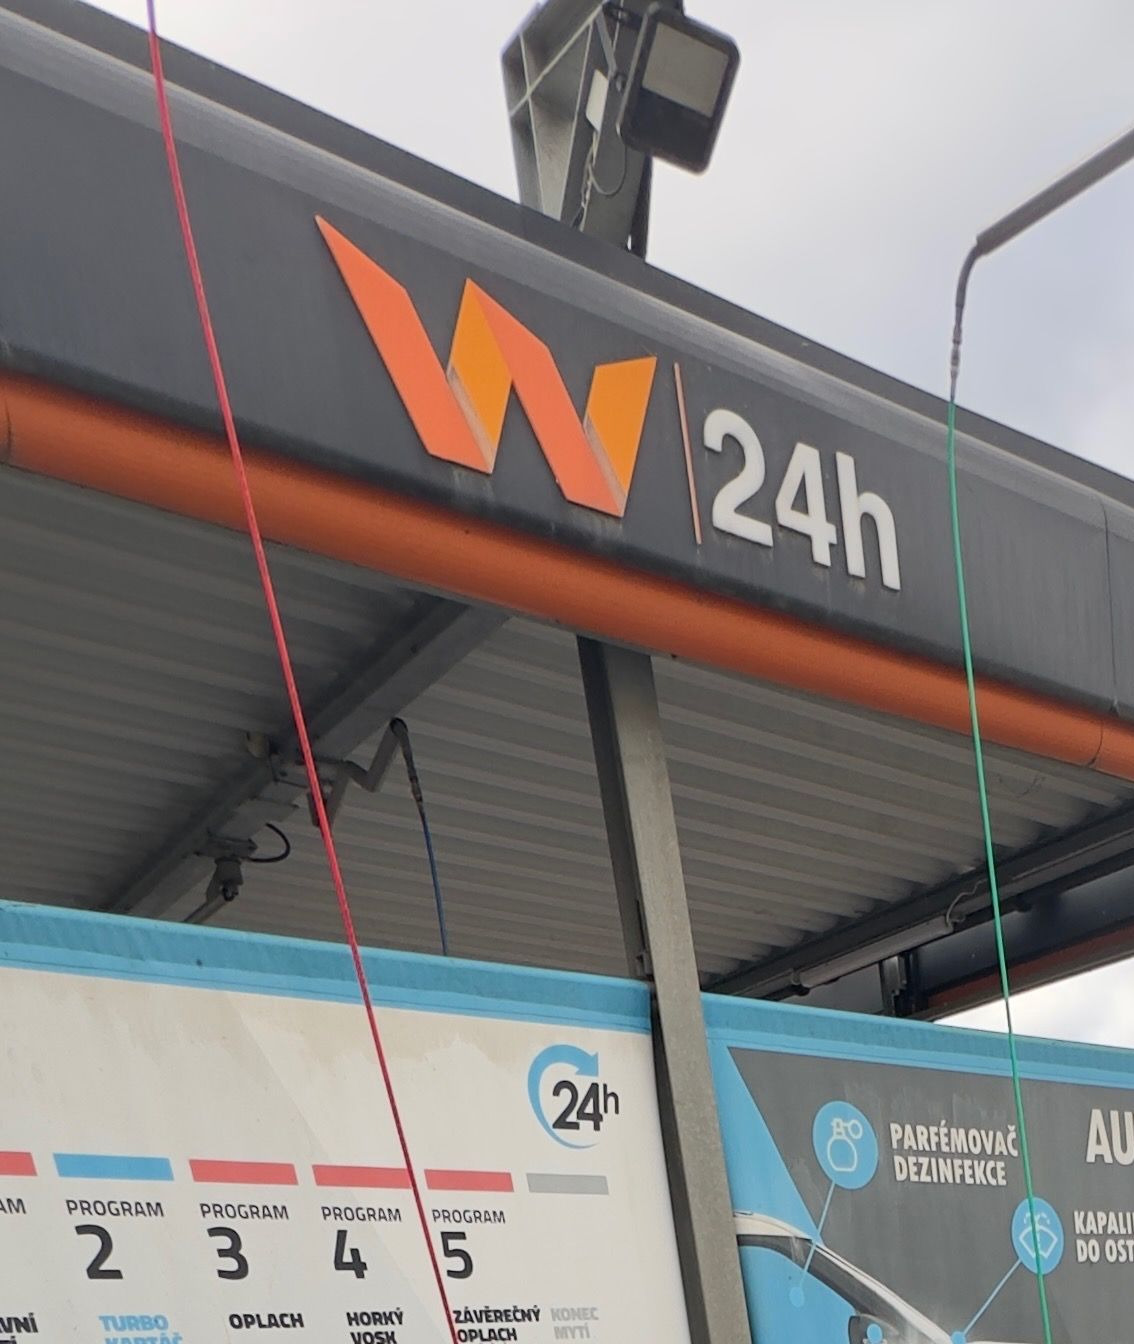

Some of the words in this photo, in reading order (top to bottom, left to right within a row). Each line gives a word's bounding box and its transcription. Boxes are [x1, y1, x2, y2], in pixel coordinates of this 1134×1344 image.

[704, 408, 900, 590] 24h
[551, 1079, 620, 1131] 24h
[890, 1120, 1019, 1158] PARFÉMOVAČ
[894, 1155, 1007, 1187] DEZINFEKCE
[66, 1199, 165, 1218] PROGRAM
[200, 1202, 290, 1220] PROGRAM
[321, 1205, 402, 1223] PROGRAM
[431, 1208, 507, 1225] PROGRAM
[75, 1224, 124, 1280] 2
[206, 1226, 250, 1280] 3
[333, 1229, 368, 1279] 4
[440, 1231, 474, 1280] 5
[1076, 1238, 1101, 1263] DO
[0, 1312, 39, 1334] VNÍ
[98, 1314, 169, 1332] TURBO
[229, 1312, 305, 1330] OPLACH
[346, 1306, 404, 1327] HORKÝ
[453, 1304, 541, 1324] ZÁVĚREČNÝ
[550, 1306, 600, 1323] KONEC
[457, 1327, 518, 1344] OPLACH
[553, 1324, 591, 1341] MYTÍ
